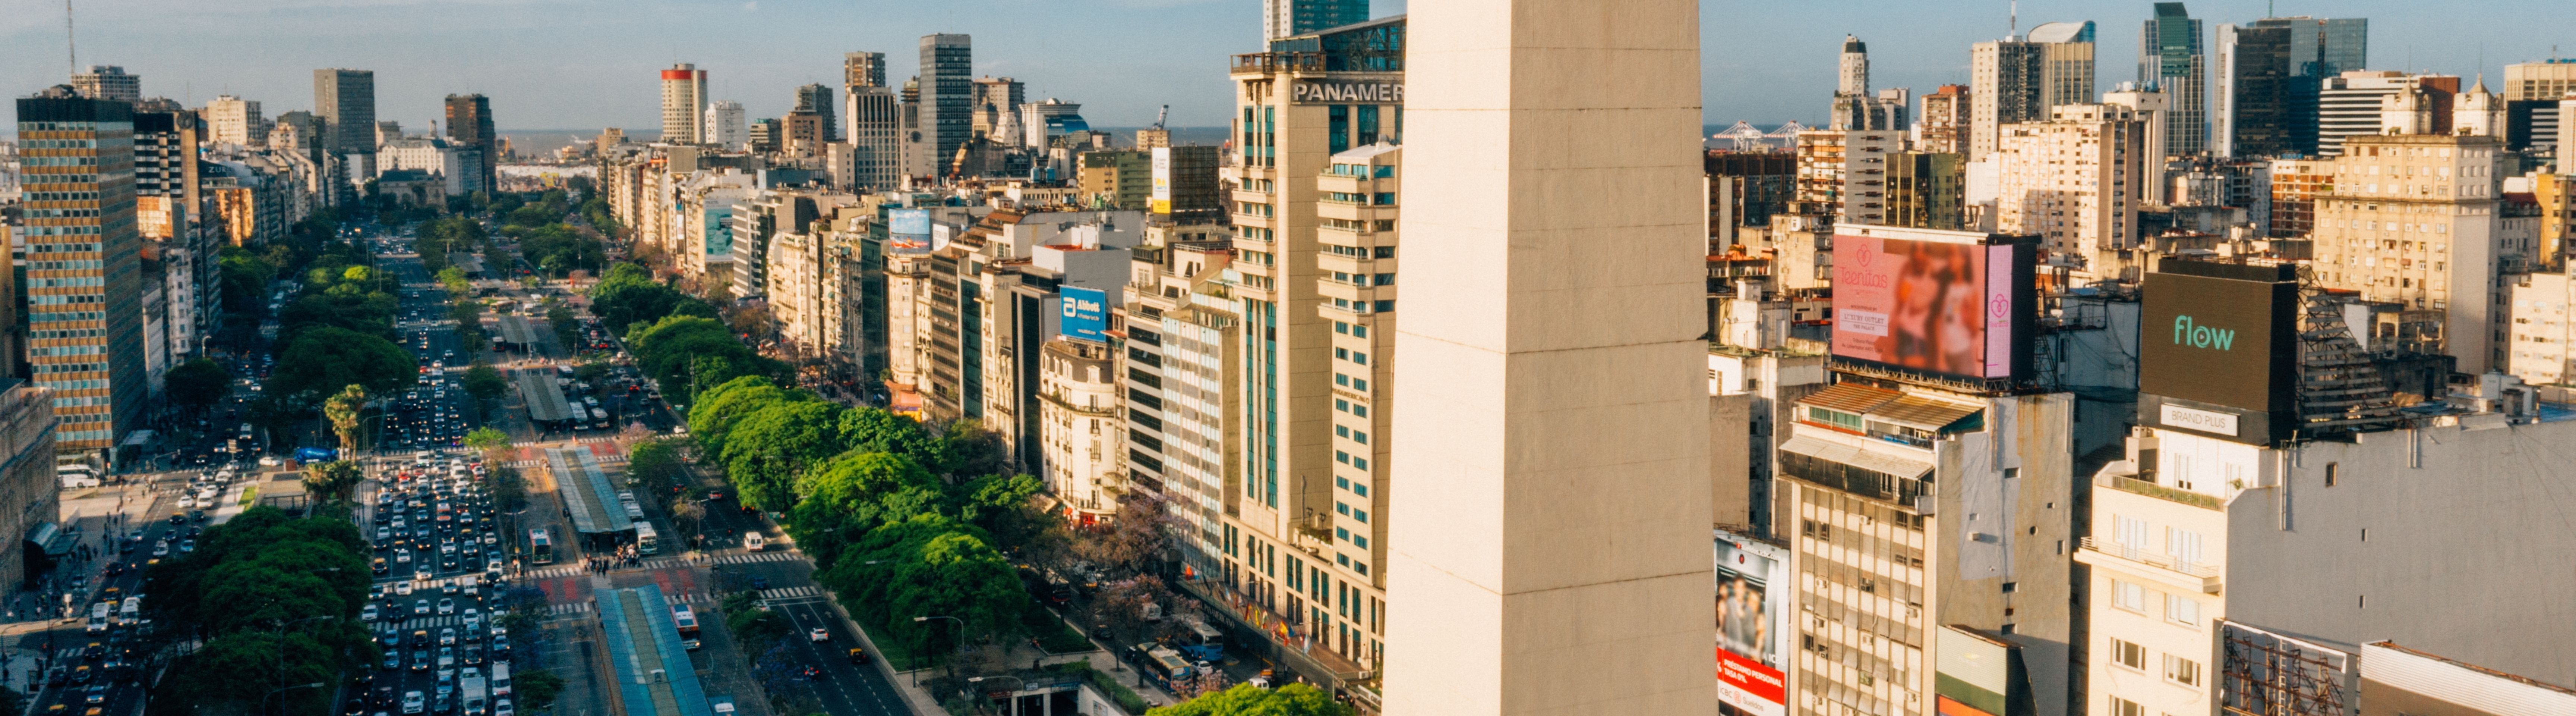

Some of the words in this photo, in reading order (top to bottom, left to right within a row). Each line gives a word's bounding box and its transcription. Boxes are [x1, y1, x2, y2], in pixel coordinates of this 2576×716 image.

[1840, 267, 1888, 288] Teenitas
[1077, 299, 1101, 313] Abbott
[1865, 315, 1884, 324] OUTLET
[2174, 315, 2235, 351] flow
[2172, 411, 2202, 424] BRAND
[2205, 414, 2226, 428] PLUS
[1724, 659, 1752, 676] PRÉSTAMO
[1768, 653, 1786, 666] ICBC
[1724, 667, 1737, 679] TASA
[1720, 686, 1732, 698] ICBC
[1743, 696, 1764, 711] Sueldos
